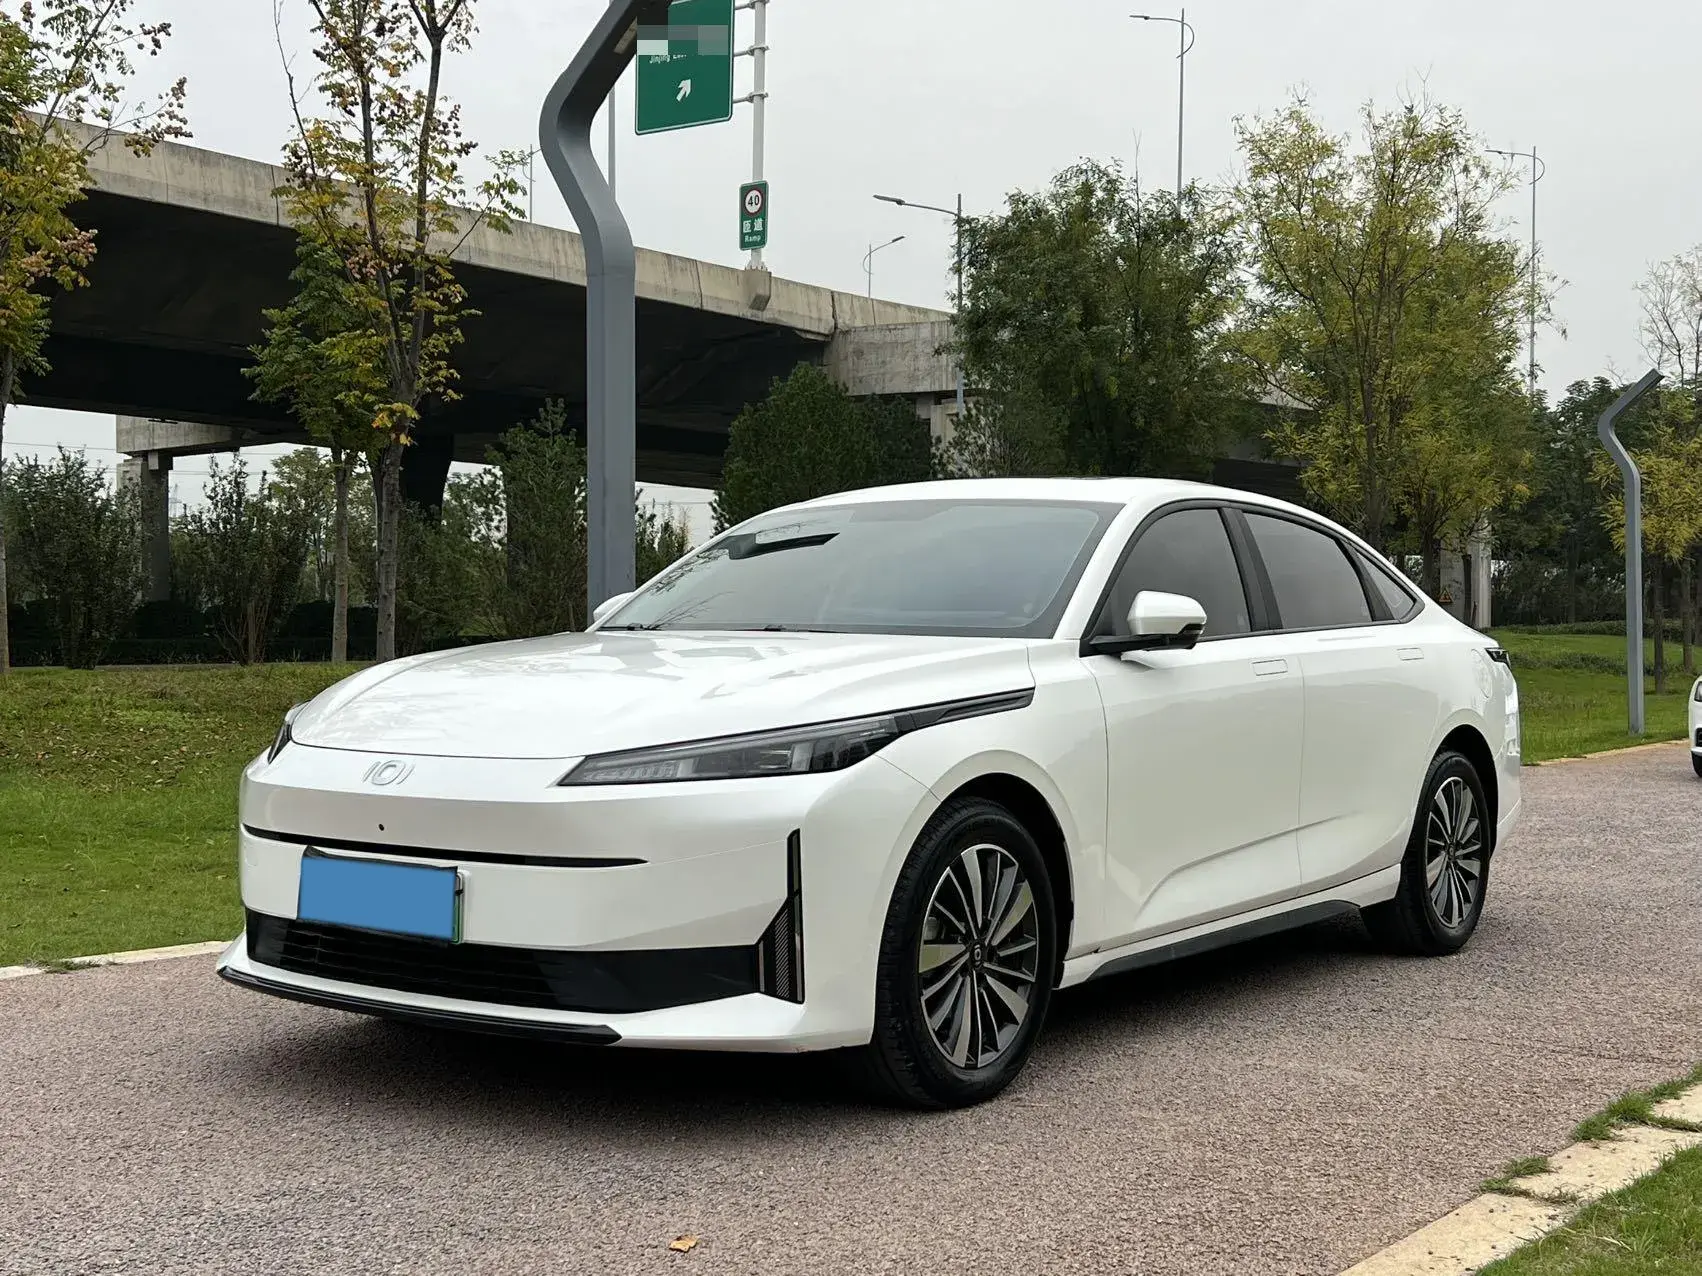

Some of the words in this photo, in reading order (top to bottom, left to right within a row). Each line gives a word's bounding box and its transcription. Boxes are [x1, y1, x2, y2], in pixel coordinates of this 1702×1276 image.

[748, 195, 760, 206] 40
[743, 217, 763, 233] 匝道
[744, 234, 761, 242] Ramp
